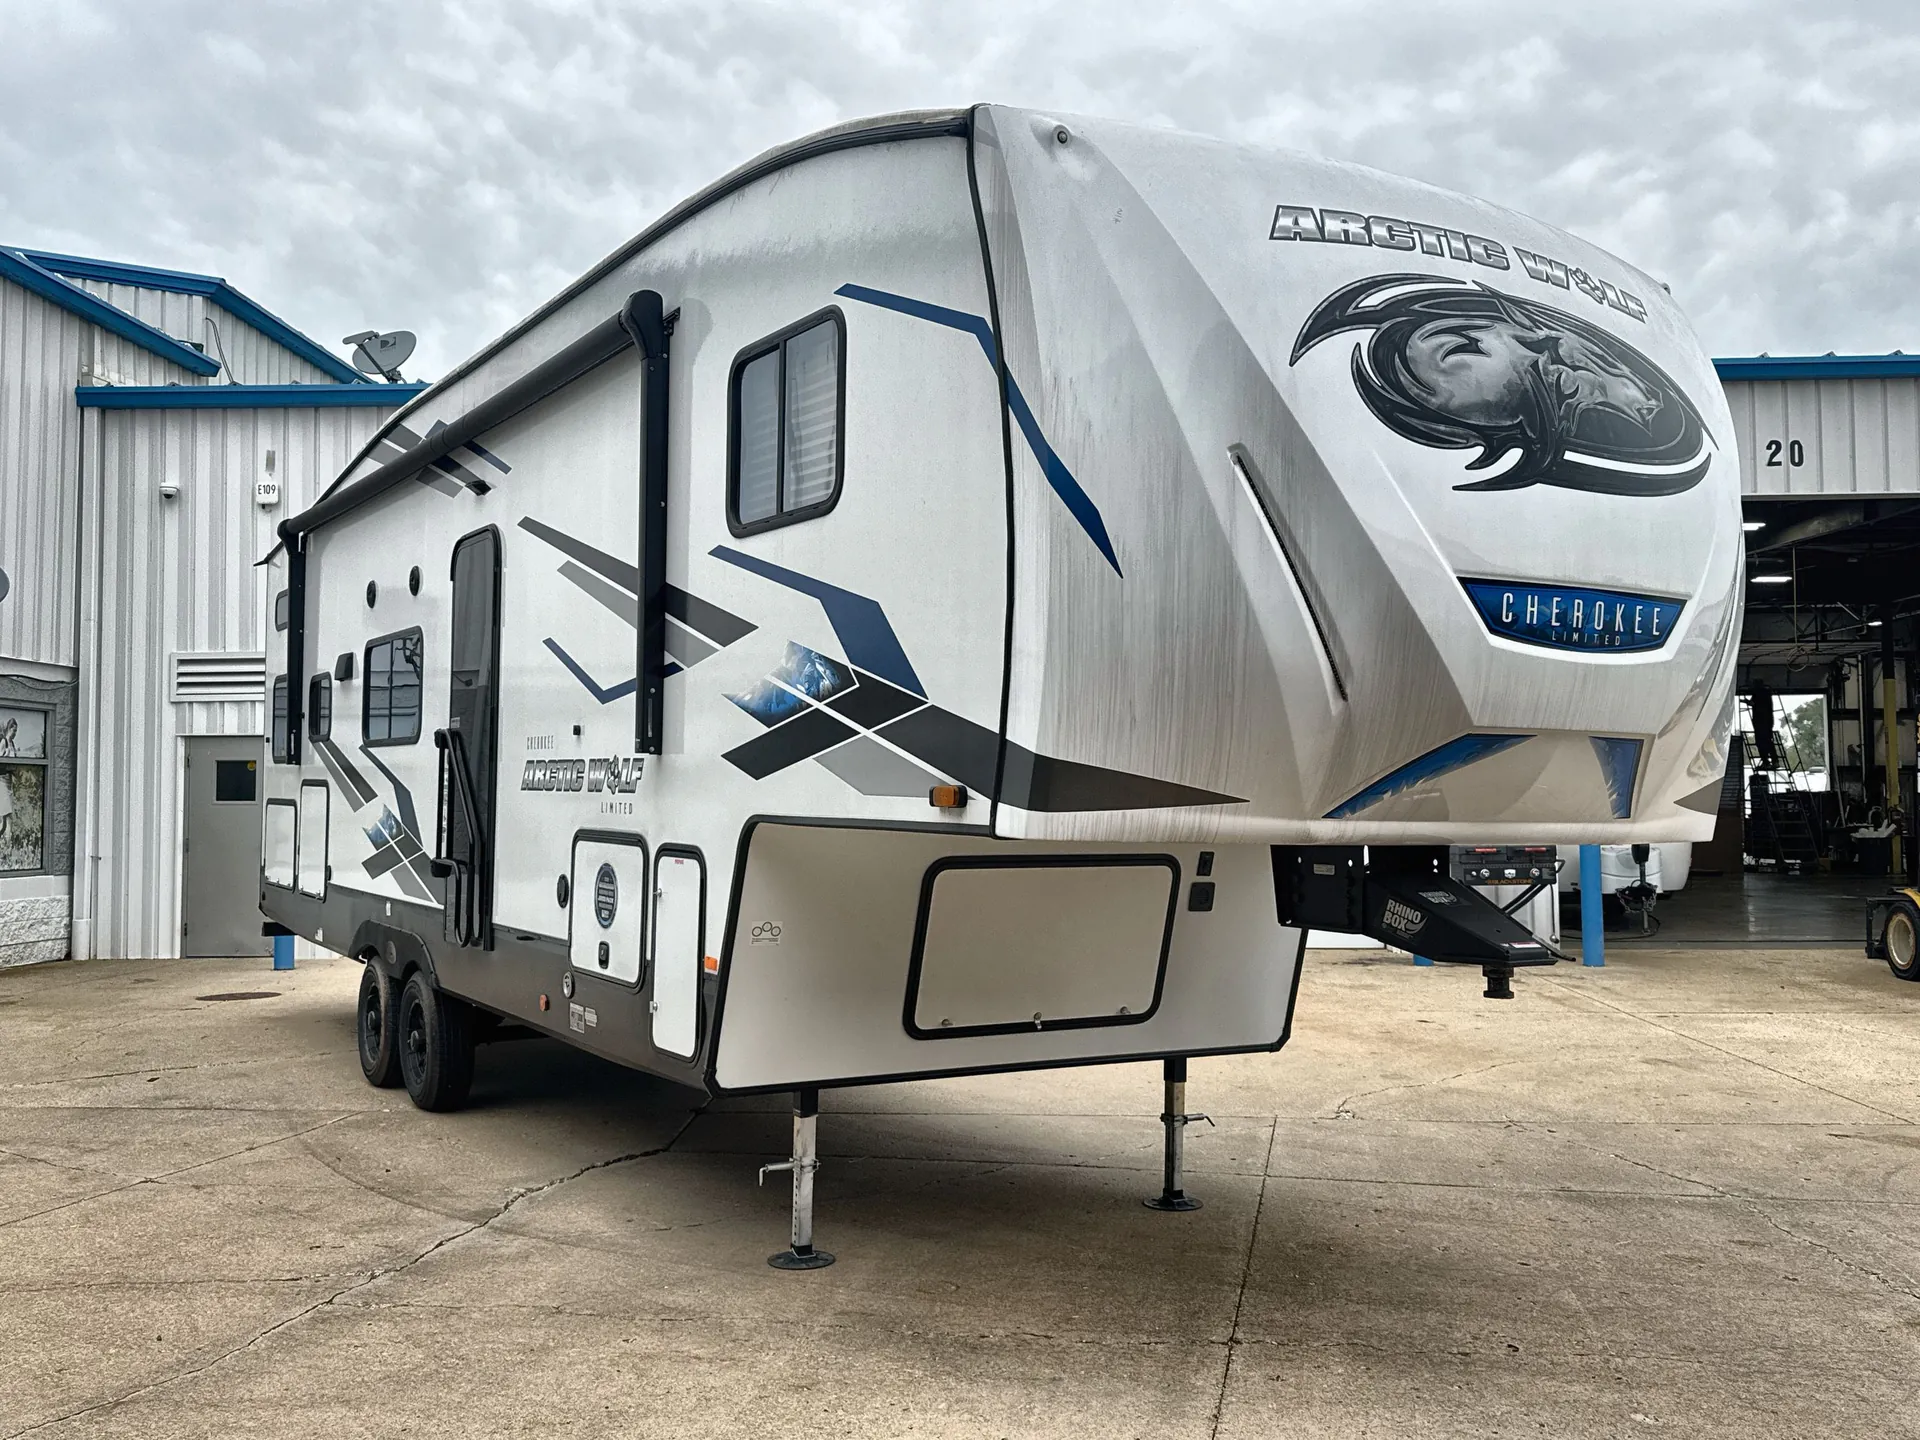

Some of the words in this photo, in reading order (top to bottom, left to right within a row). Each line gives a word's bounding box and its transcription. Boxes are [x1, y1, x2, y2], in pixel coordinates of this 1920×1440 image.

[1269, 204, 1510, 271] ARCTIC
[1766, 439, 1804, 467] 20
[257, 484, 276, 495] E109
[1502, 592, 1661, 636] CHEROKEE
[1551, 630, 1621, 646] LIMITED
[520, 759, 586, 792] ARCTIC
[600, 801, 633, 815] LIMITED
[1382, 910, 1409, 932] BOX
[1386, 898, 1422, 924] RHINO
